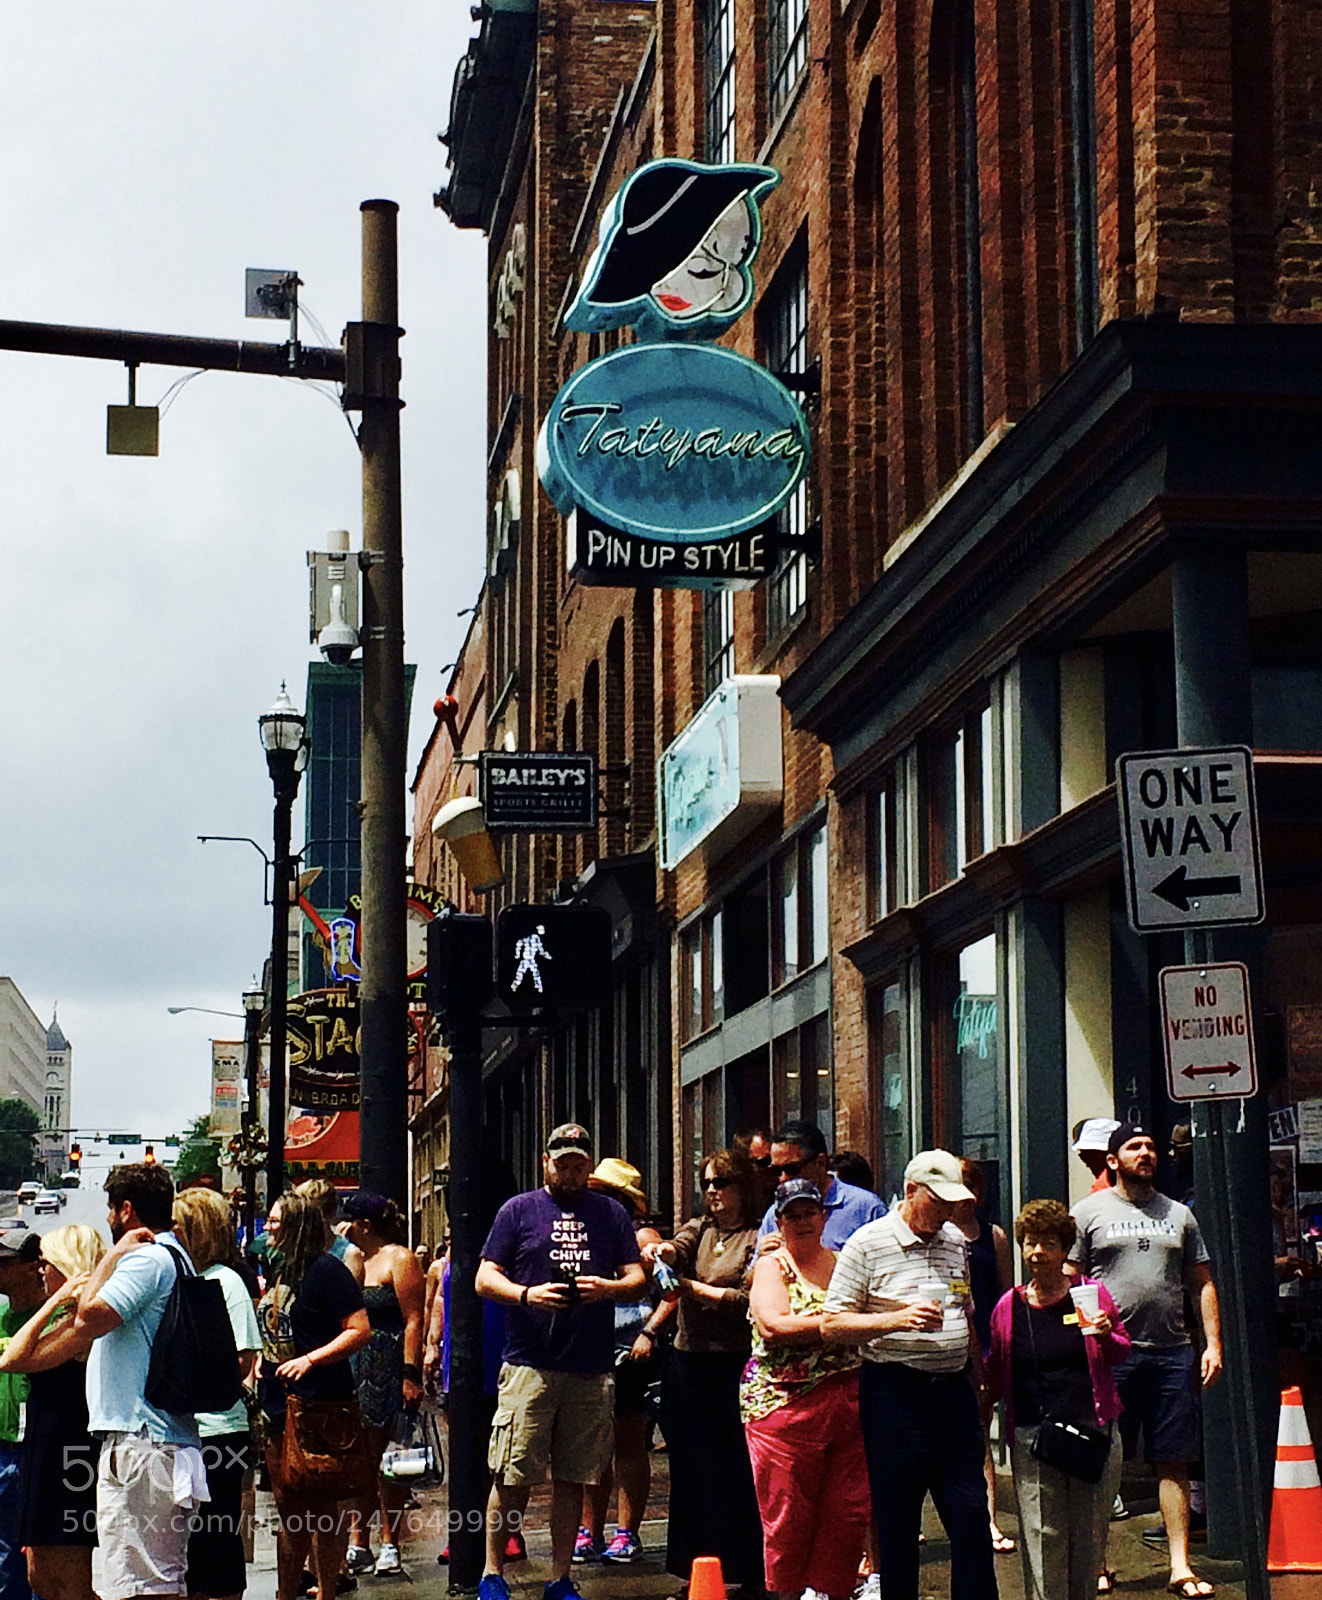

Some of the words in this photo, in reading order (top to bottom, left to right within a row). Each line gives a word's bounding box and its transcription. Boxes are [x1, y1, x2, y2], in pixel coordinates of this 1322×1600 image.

[560, 402, 805, 471] Tatyana
[587, 529, 630, 567] PIN
[640, 544, 675, 570] UP
[684, 534, 765, 572] STYLE
[491, 768, 585, 786] BAILEY'S
[1139, 764, 1237, 809] ONE
[1140, 811, 1242, 858] WAY
[1194, 985, 1217, 1007] NO
[1171, 1015, 1245, 1041] VENDING
[311, 1091, 361, 1105] BROAD
[552, 1220, 585, 1231] KEEP
[550, 1232, 588, 1242] CALM
[549, 1249, 591, 1261] CHIVE
